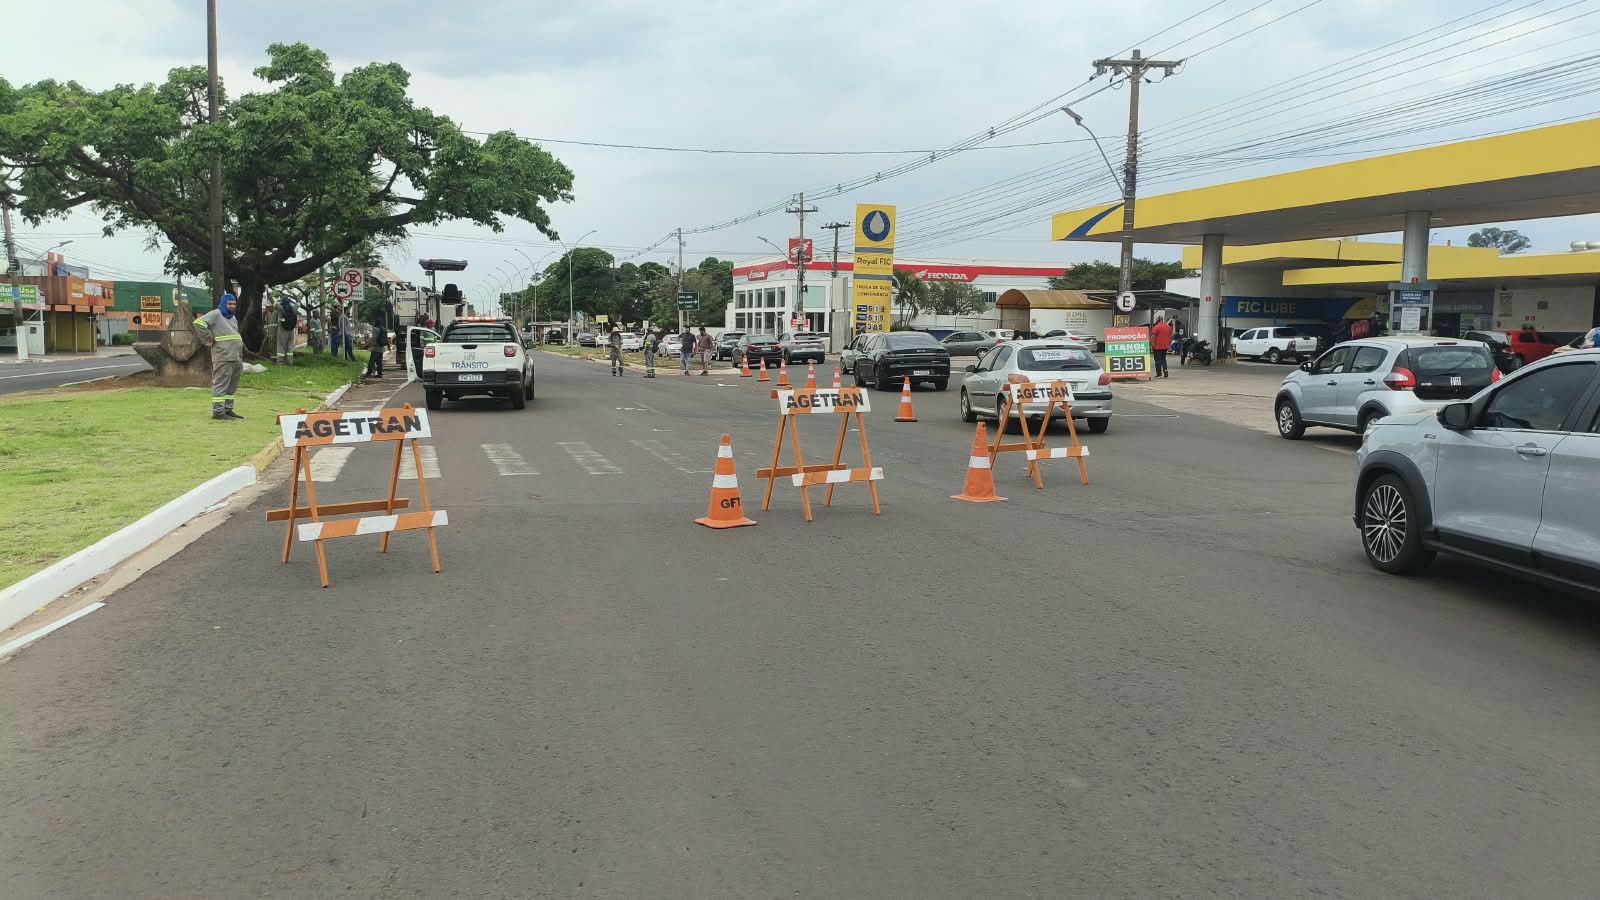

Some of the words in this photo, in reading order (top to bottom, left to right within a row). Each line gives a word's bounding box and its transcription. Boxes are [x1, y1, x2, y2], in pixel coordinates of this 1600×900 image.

[857, 257, 878, 266] Royal
[1123, 296, 1131, 308] E
[1237, 301, 1260, 313] FIC
[1264, 302, 1296, 313] LUBE
[451, 361, 489, 369] TRÂNSITO
[1113, 357, 1143, 371] 3,85
[1016, 386, 1070, 400] AGETRAN
[786, 392, 864, 409] AGETRAN
[294, 415, 422, 440] AGETRAN
